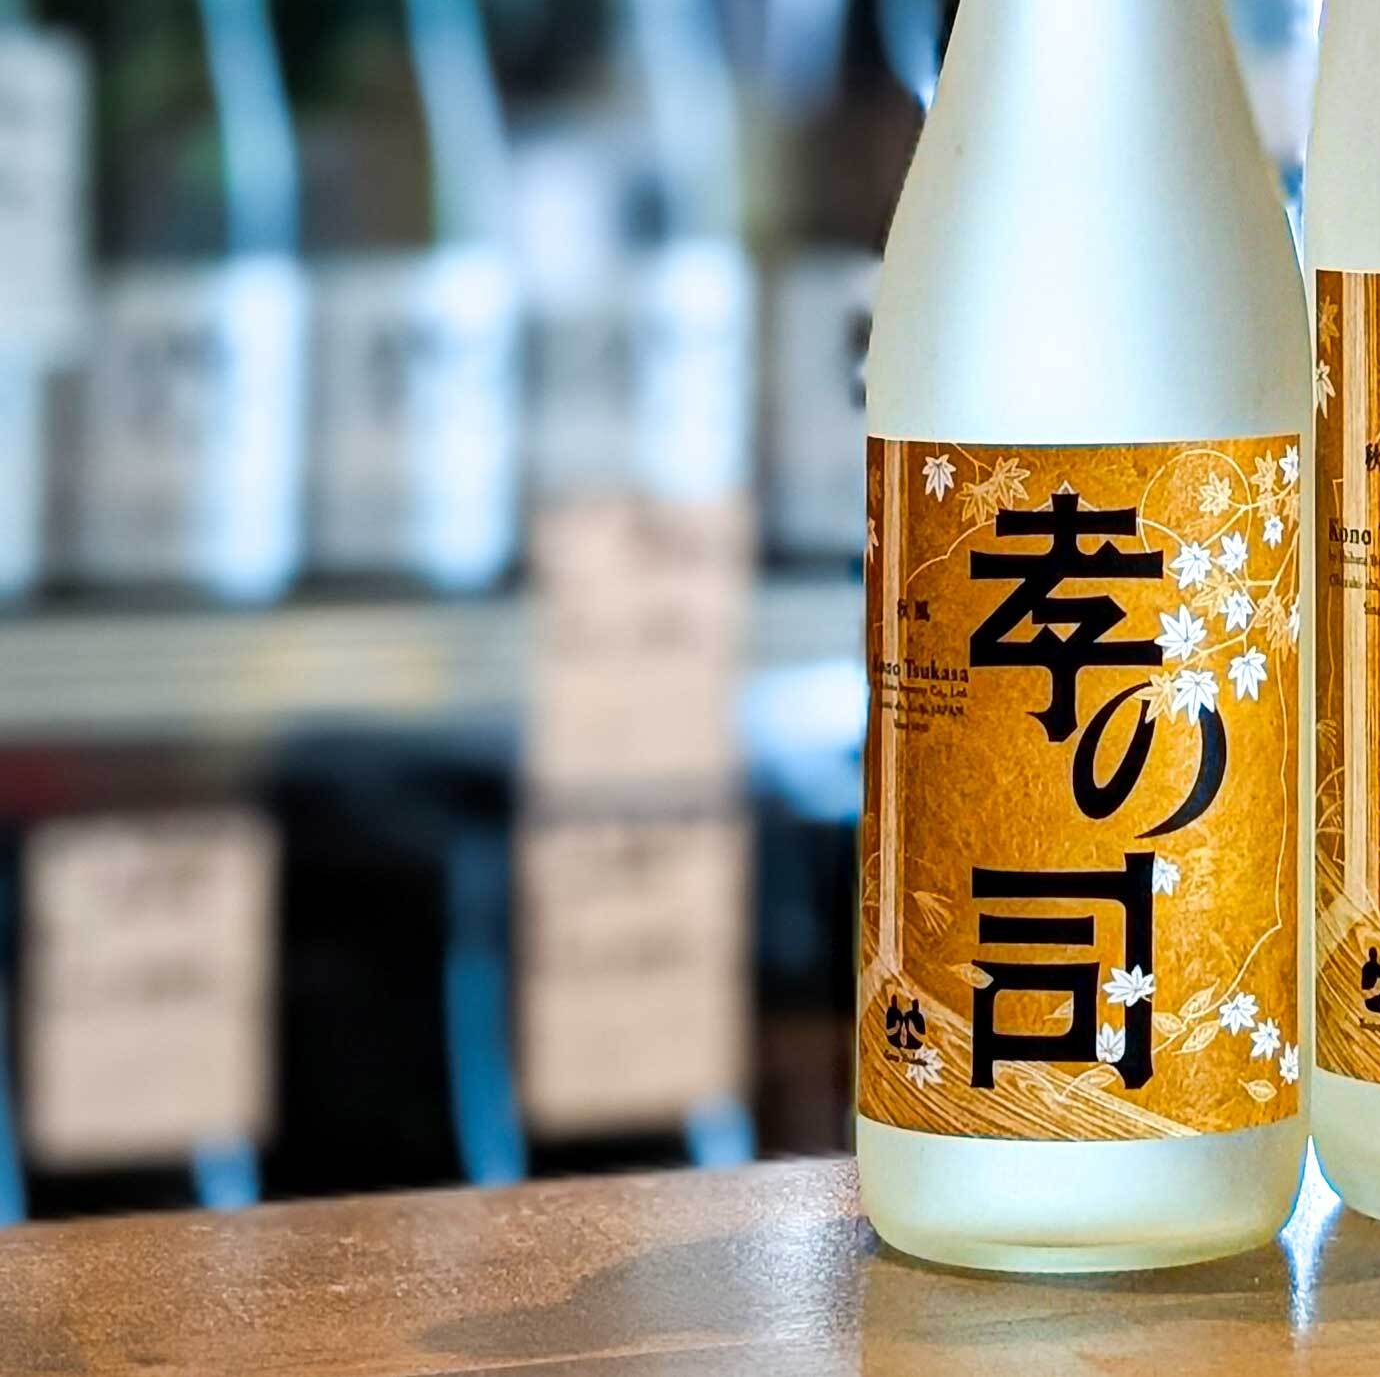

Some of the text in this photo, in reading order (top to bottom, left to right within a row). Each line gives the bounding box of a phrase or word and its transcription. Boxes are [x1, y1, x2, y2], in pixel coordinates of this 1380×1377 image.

[1328, 518, 1372, 545] Kono
[904, 656, 969, 683] Tsukasa
[970, 492, 1227, 1090] 孝の司
